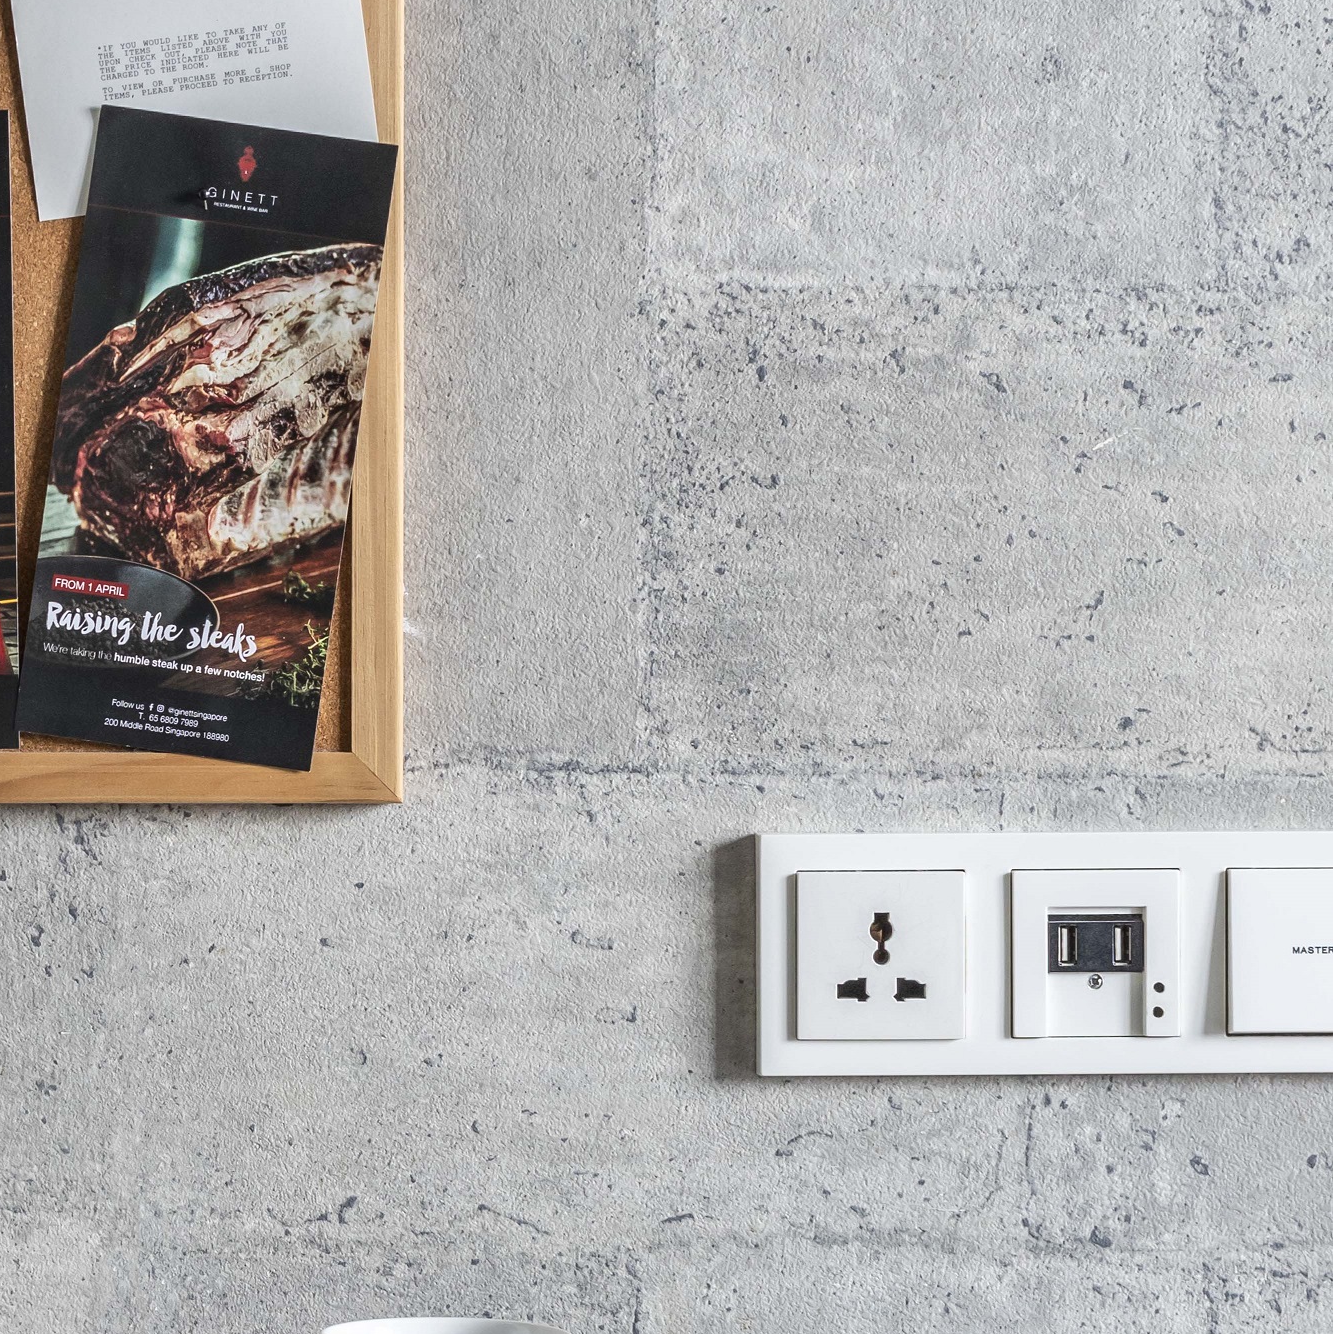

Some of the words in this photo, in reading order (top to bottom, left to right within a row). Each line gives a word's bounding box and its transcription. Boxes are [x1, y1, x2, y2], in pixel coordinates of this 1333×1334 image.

[207, 186, 279, 206] GINETT
[45, 601, 136, 646] Raising
[140, 610, 184, 643] the
[186, 617, 261, 663] steaks
